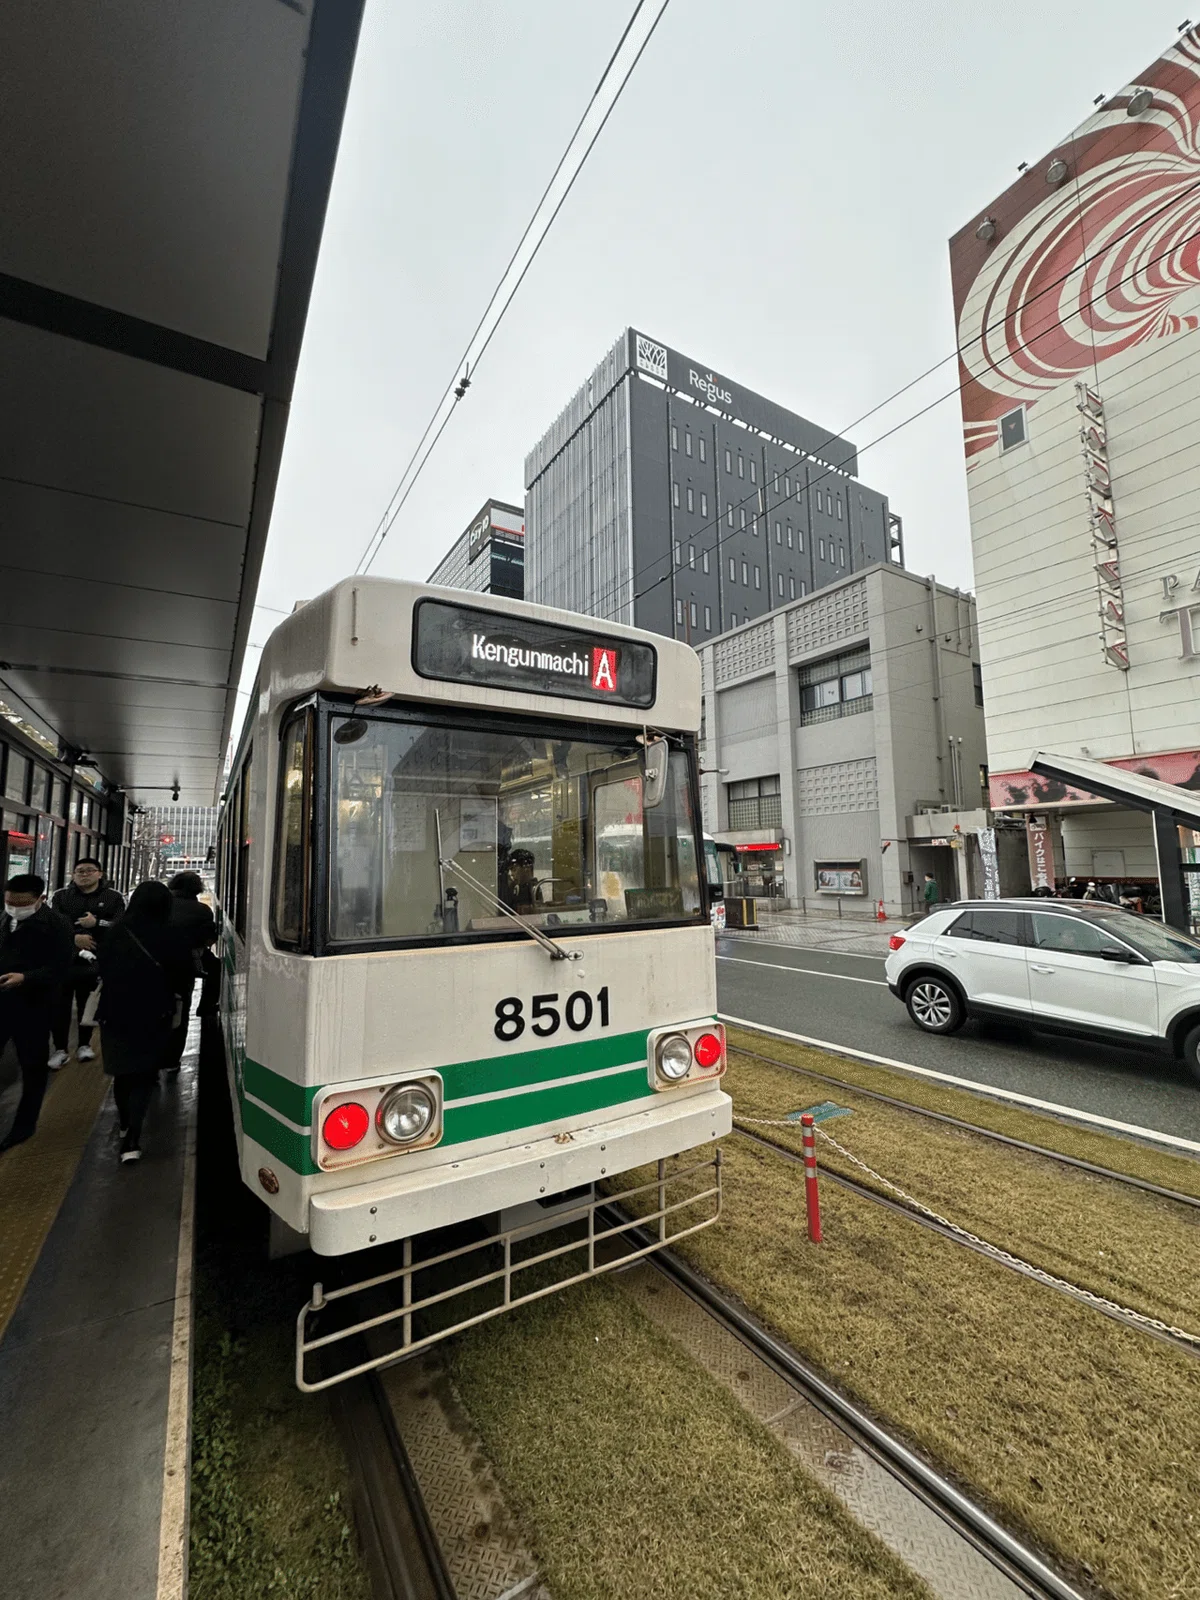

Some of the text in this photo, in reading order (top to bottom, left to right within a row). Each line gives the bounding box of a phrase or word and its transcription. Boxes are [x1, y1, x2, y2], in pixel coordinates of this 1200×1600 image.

[689, 369, 733, 404] Regus
[472, 634, 614, 688] Kengunmachi A
[494, 986, 609, 1042] 8501
